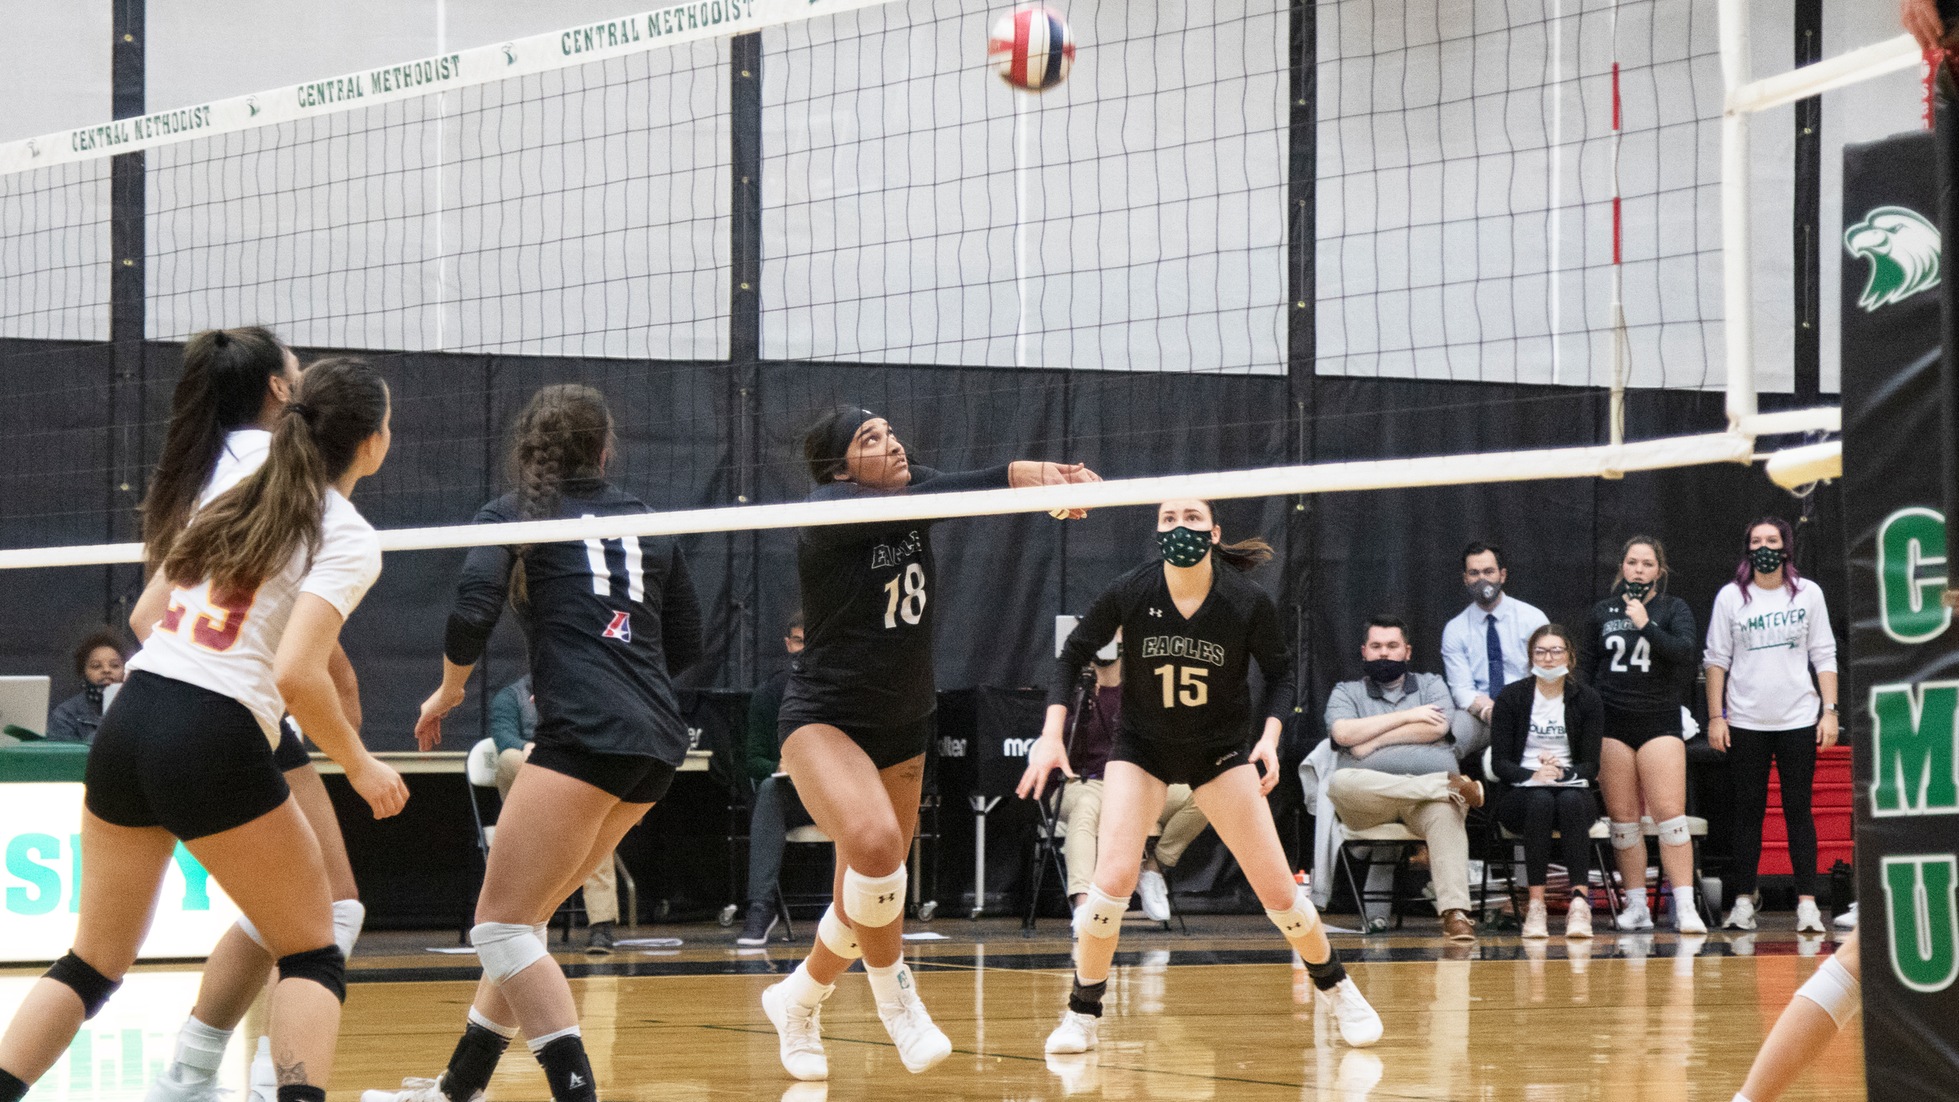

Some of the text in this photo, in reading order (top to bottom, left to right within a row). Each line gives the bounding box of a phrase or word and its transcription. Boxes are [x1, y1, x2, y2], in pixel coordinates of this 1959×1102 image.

[560, 0, 752, 55] CENTRAL METHODIST
[297, 54, 461, 109] CENTRAL METHODIST
[71, 105, 211, 152] CENTRAL METHODIST
[580, 514, 645, 603] 11
[884, 562, 926, 629] 18
[1740, 608, 1806, 633] WHATEVER
[1142, 635, 1225, 667] EAGLES
[1605, 634, 1652, 673] 24
[1154, 663, 1209, 709] 15
